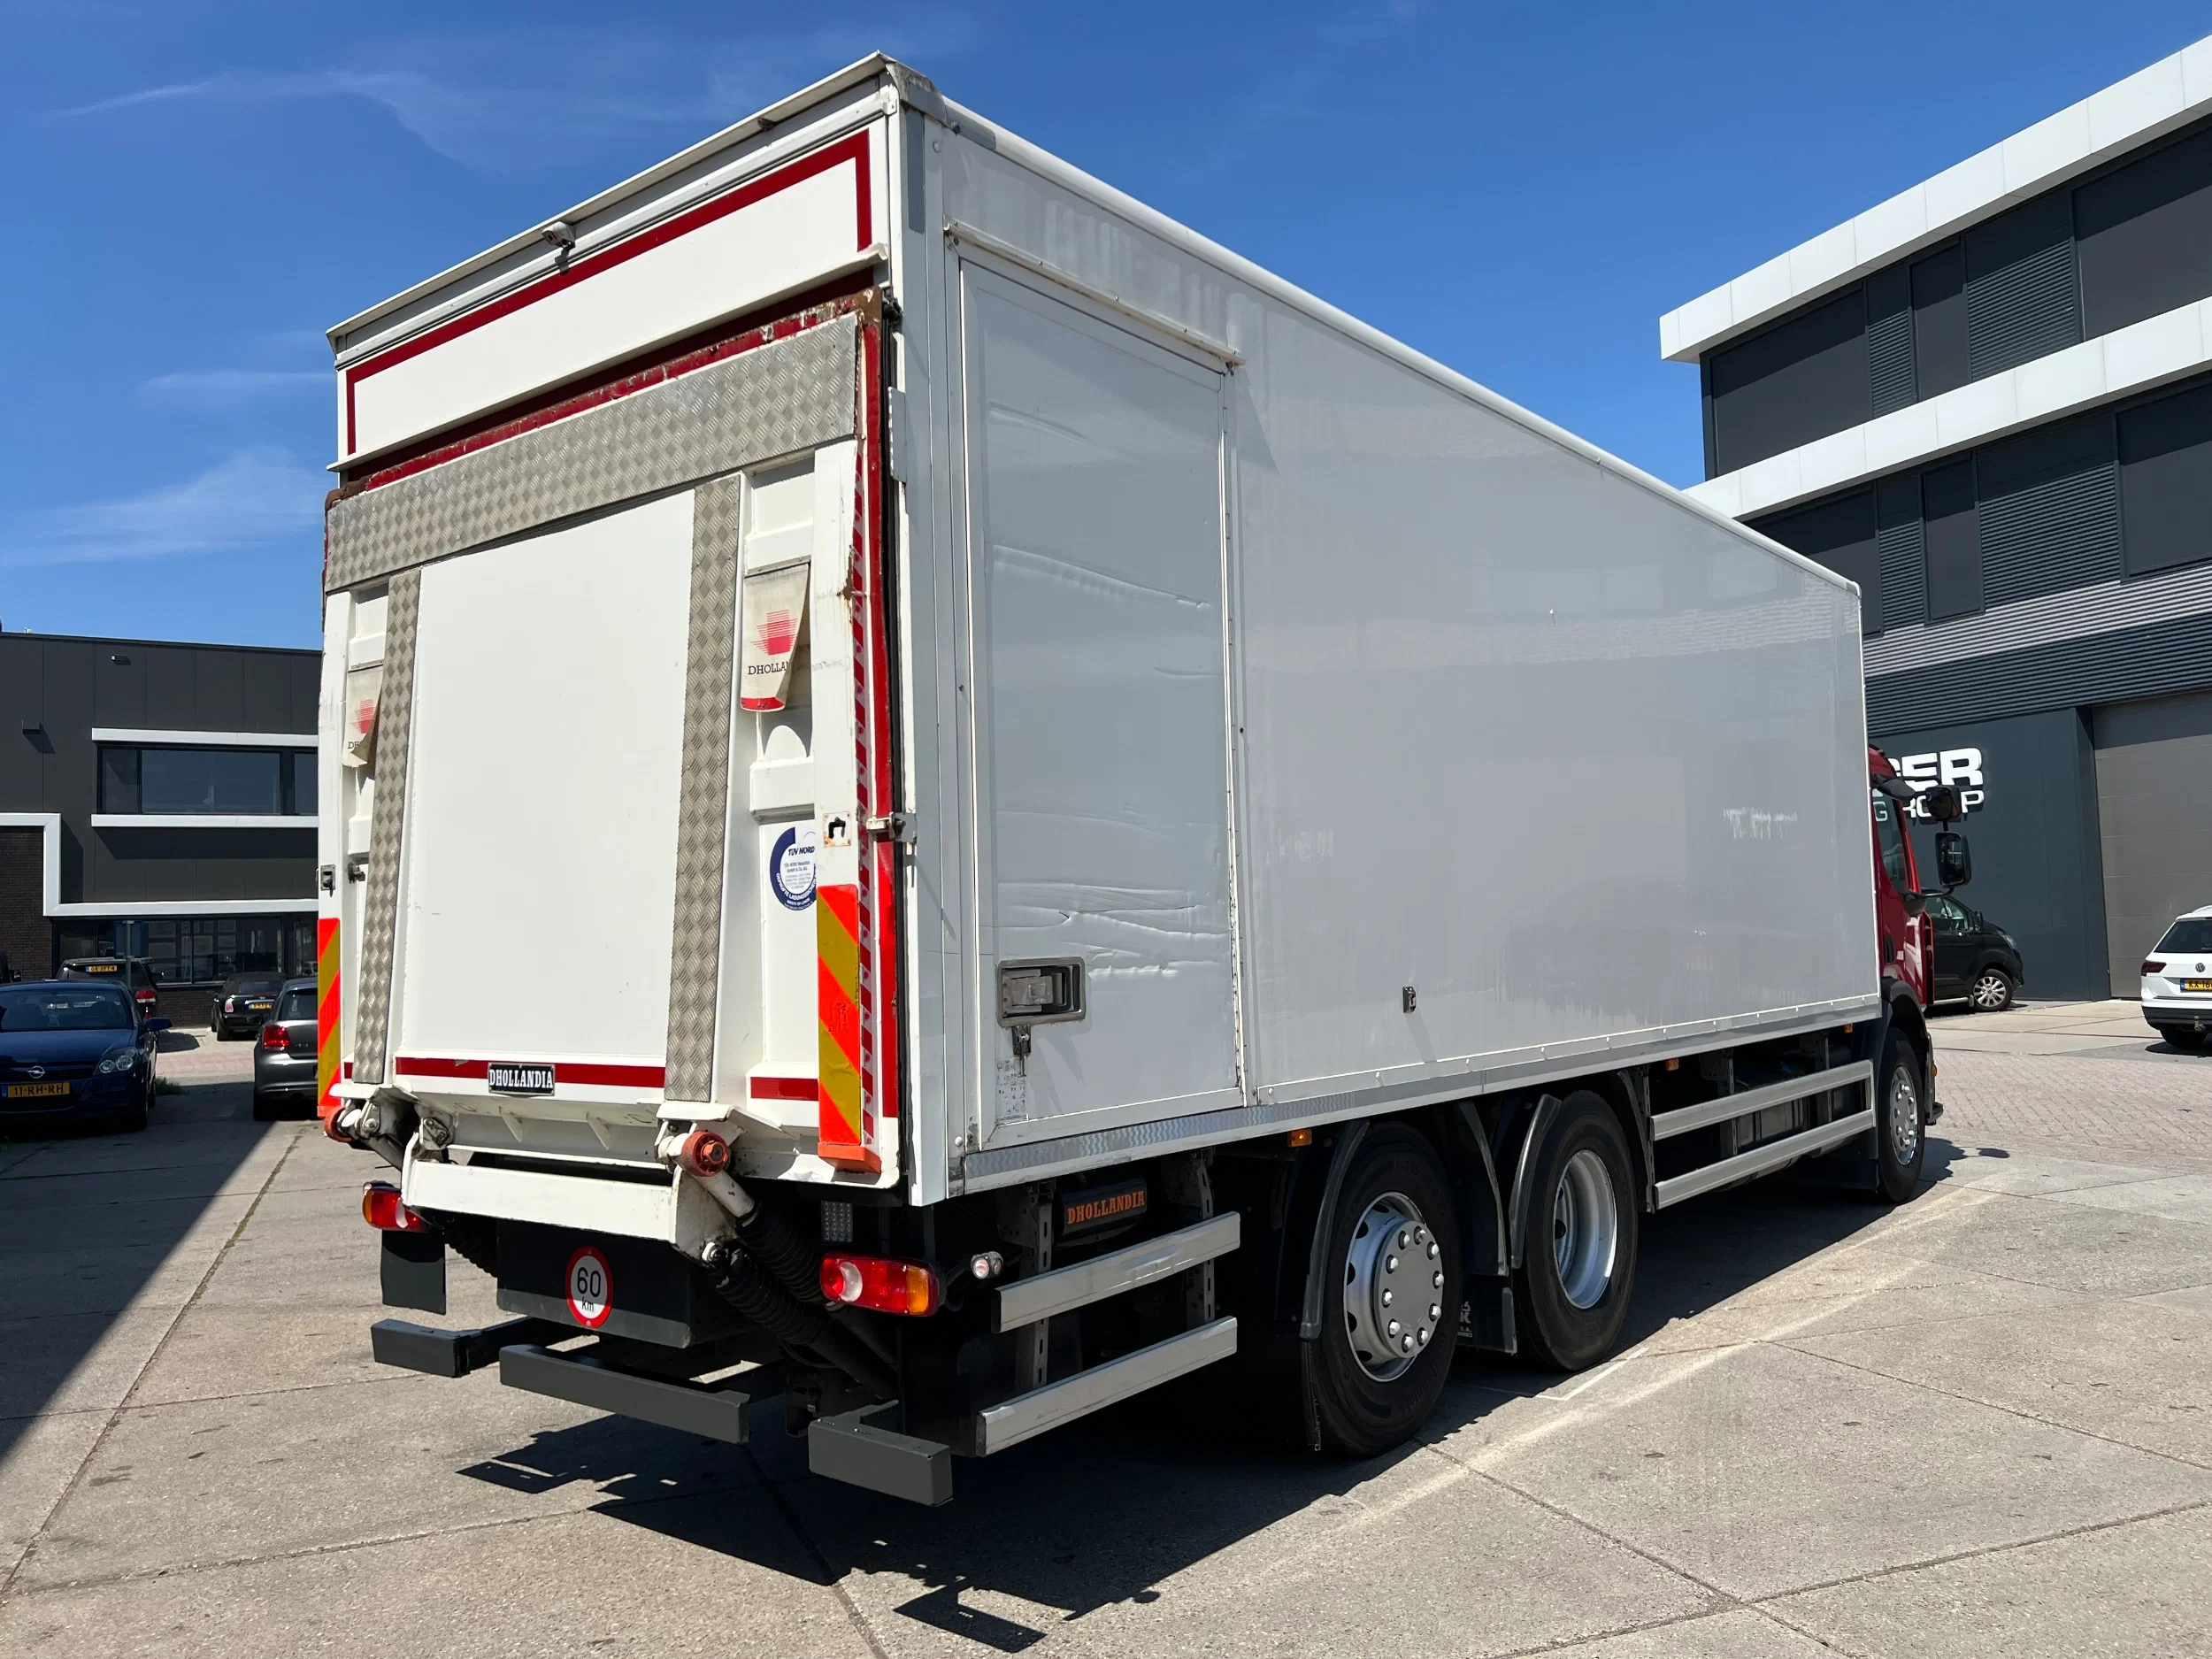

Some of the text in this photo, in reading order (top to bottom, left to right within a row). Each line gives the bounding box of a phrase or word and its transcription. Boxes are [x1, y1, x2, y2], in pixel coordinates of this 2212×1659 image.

[788, 846, 815, 856] TÜV NORD
[488, 1069, 554, 1089] DHOLLANDIA
[14, 1084, 64, 1097] 11-RH-RH
[1067, 1190, 1146, 1225] DHOLLANDIA
[577, 1266, 602, 1298] 60
[581, 1296, 595, 1312] km
